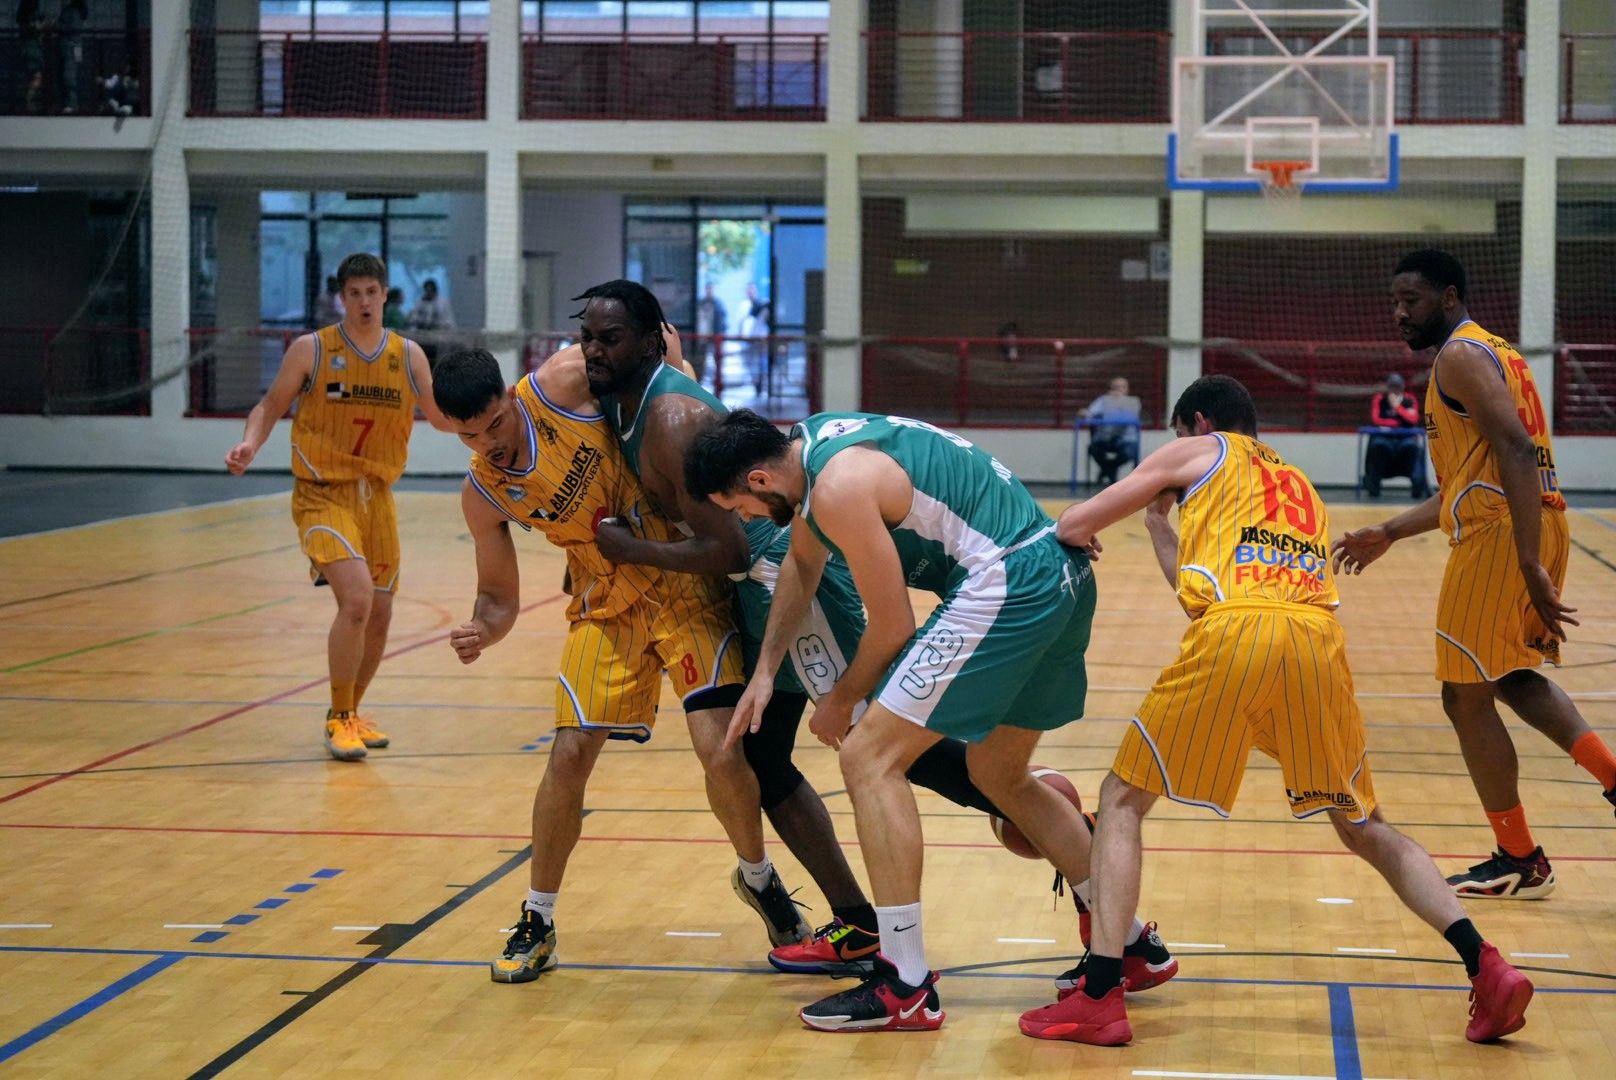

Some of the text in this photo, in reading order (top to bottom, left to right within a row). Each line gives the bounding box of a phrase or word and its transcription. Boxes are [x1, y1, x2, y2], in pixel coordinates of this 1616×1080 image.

[352, 417, 375, 457] 7
[550, 440, 595, 512] BAUBLOCK
[1252, 455, 1317, 535] 19
[681, 652, 698, 686] 8
